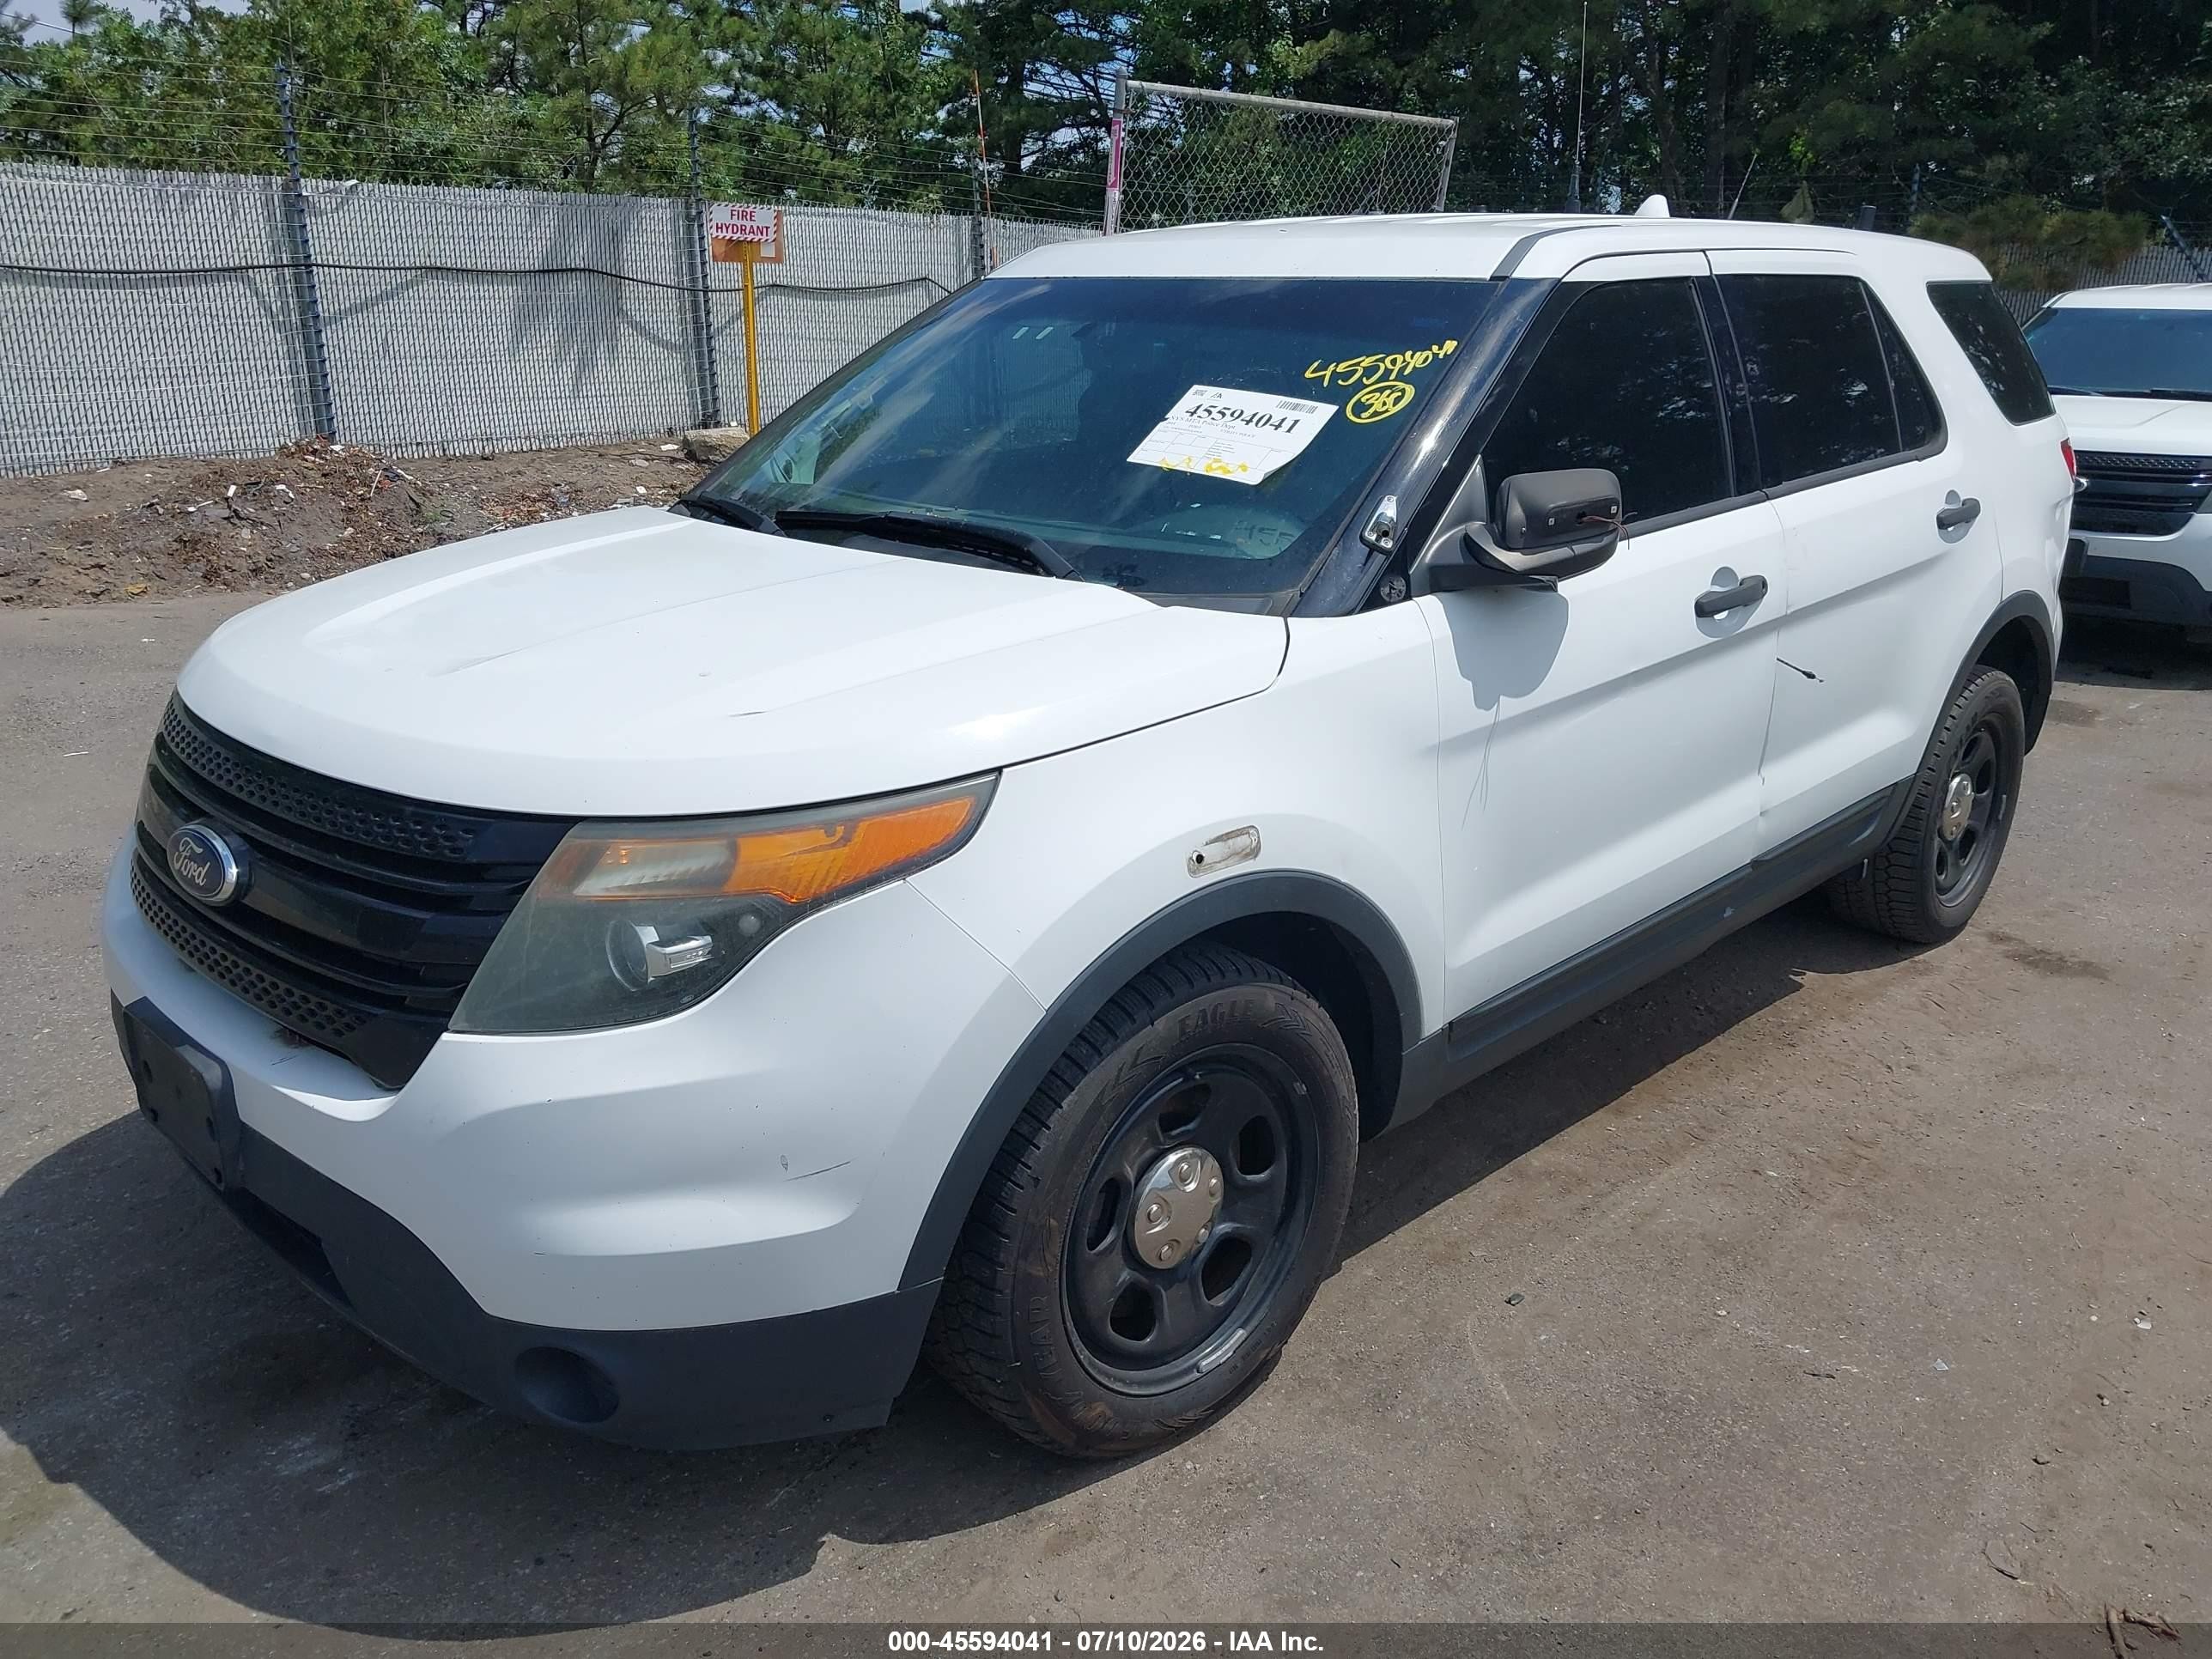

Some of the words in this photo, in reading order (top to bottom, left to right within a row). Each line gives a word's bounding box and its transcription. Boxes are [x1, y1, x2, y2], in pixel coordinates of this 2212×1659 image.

[715, 222, 770, 237] HYDRANT
[730, 209, 757, 222] FIRE
[1184, 403, 1301, 434] 45594041
[174, 837, 210, 886] Ford
[1175, 999, 1257, 1037] EAGLE
